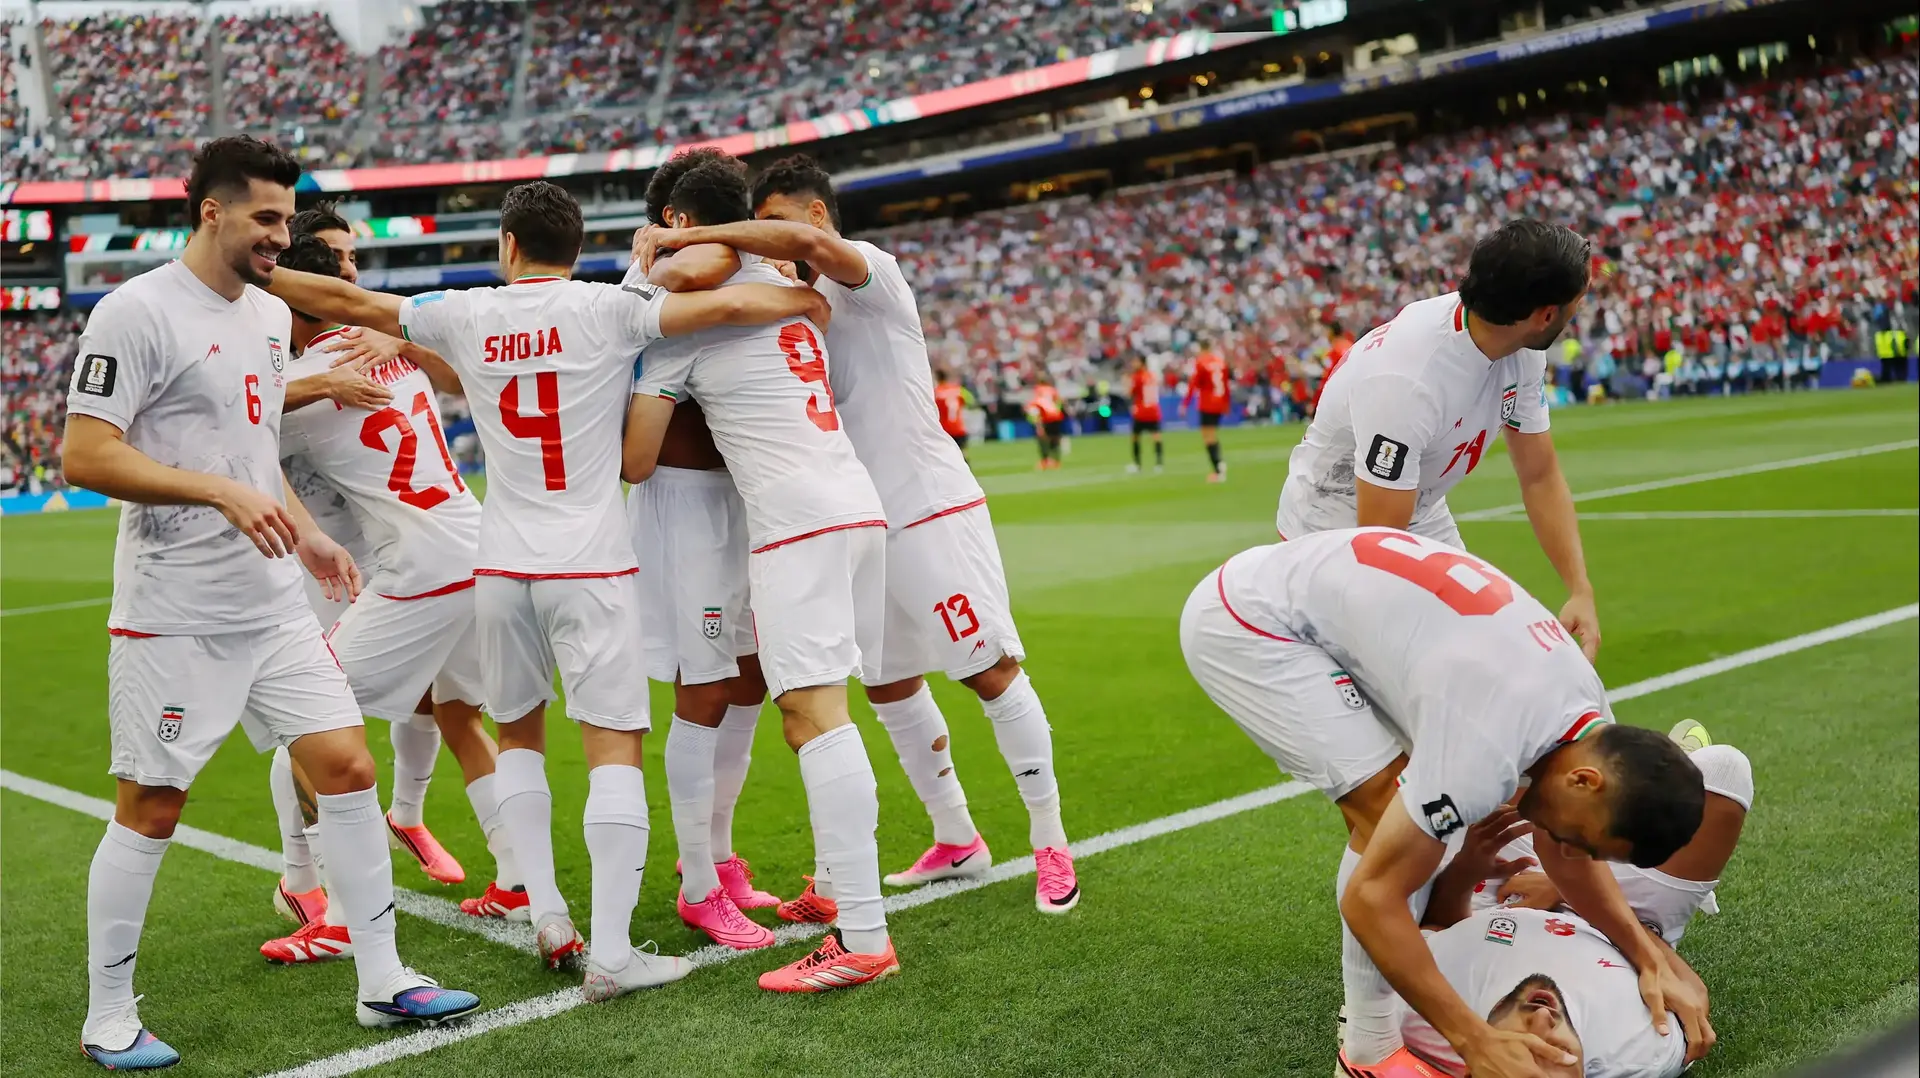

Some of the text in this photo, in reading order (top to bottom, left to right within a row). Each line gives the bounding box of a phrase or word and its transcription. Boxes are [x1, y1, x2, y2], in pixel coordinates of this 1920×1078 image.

[484, 327, 563, 363] SHOJA
[777, 321, 839, 432] 9
[245, 374, 262, 425] 6
[499, 371, 567, 491] 4
[359, 391, 466, 511] 21
[933, 593, 980, 643] 13
